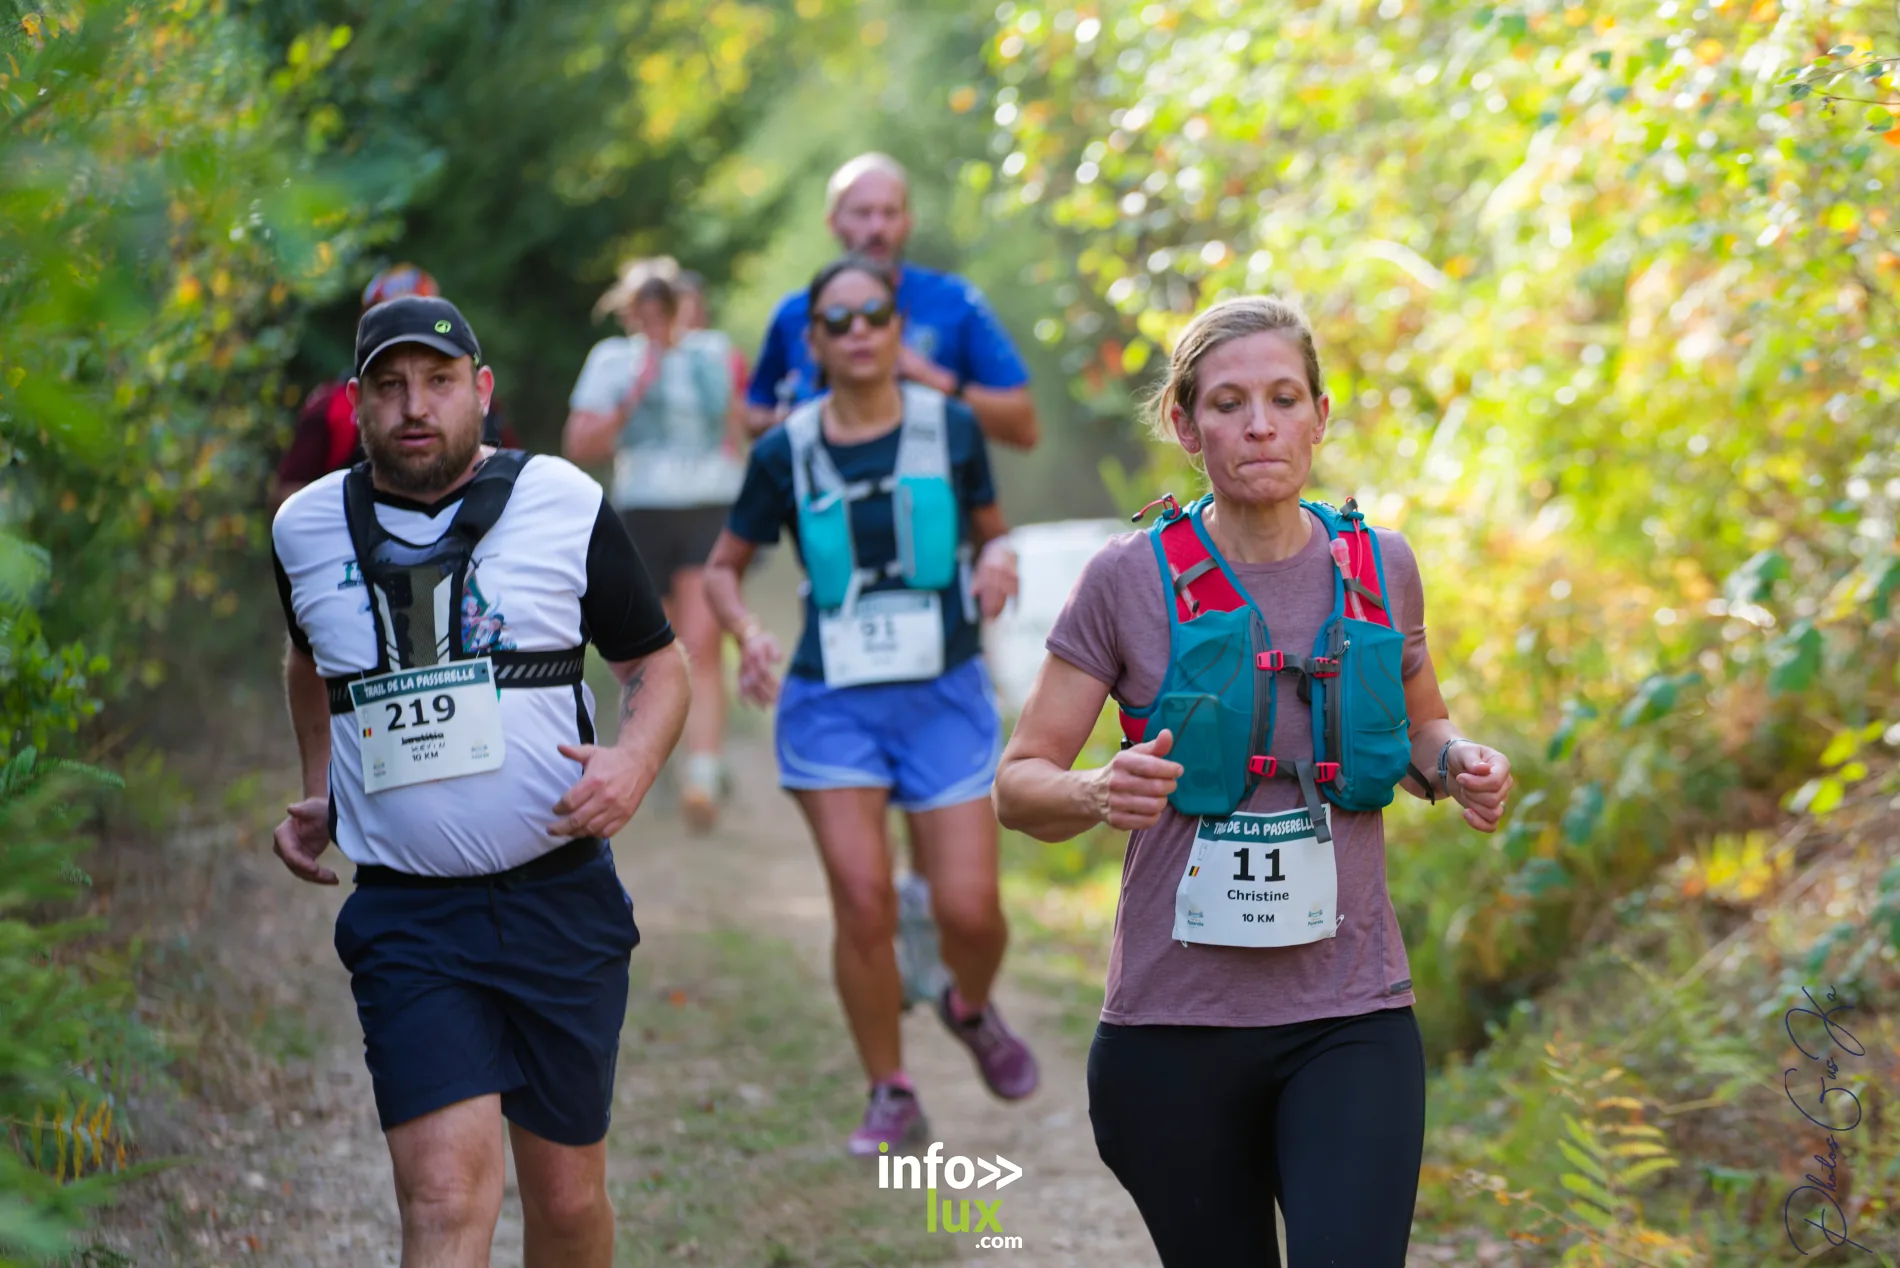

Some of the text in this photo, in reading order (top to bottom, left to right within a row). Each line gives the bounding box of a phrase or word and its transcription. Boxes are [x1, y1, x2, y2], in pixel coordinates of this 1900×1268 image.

[364, 667, 476, 699] TRAIL DE LA PASSERELLE
[385, 693, 456, 732] 219
[412, 751, 439, 762] 10 KM
[1226, 821, 1241, 834] DE
[1243, 822, 1260, 836] LA
[1233, 848, 1286, 882] 11
[1227, 889, 1290, 901] Christine
[1242, 913, 1275, 923] 10 KM
